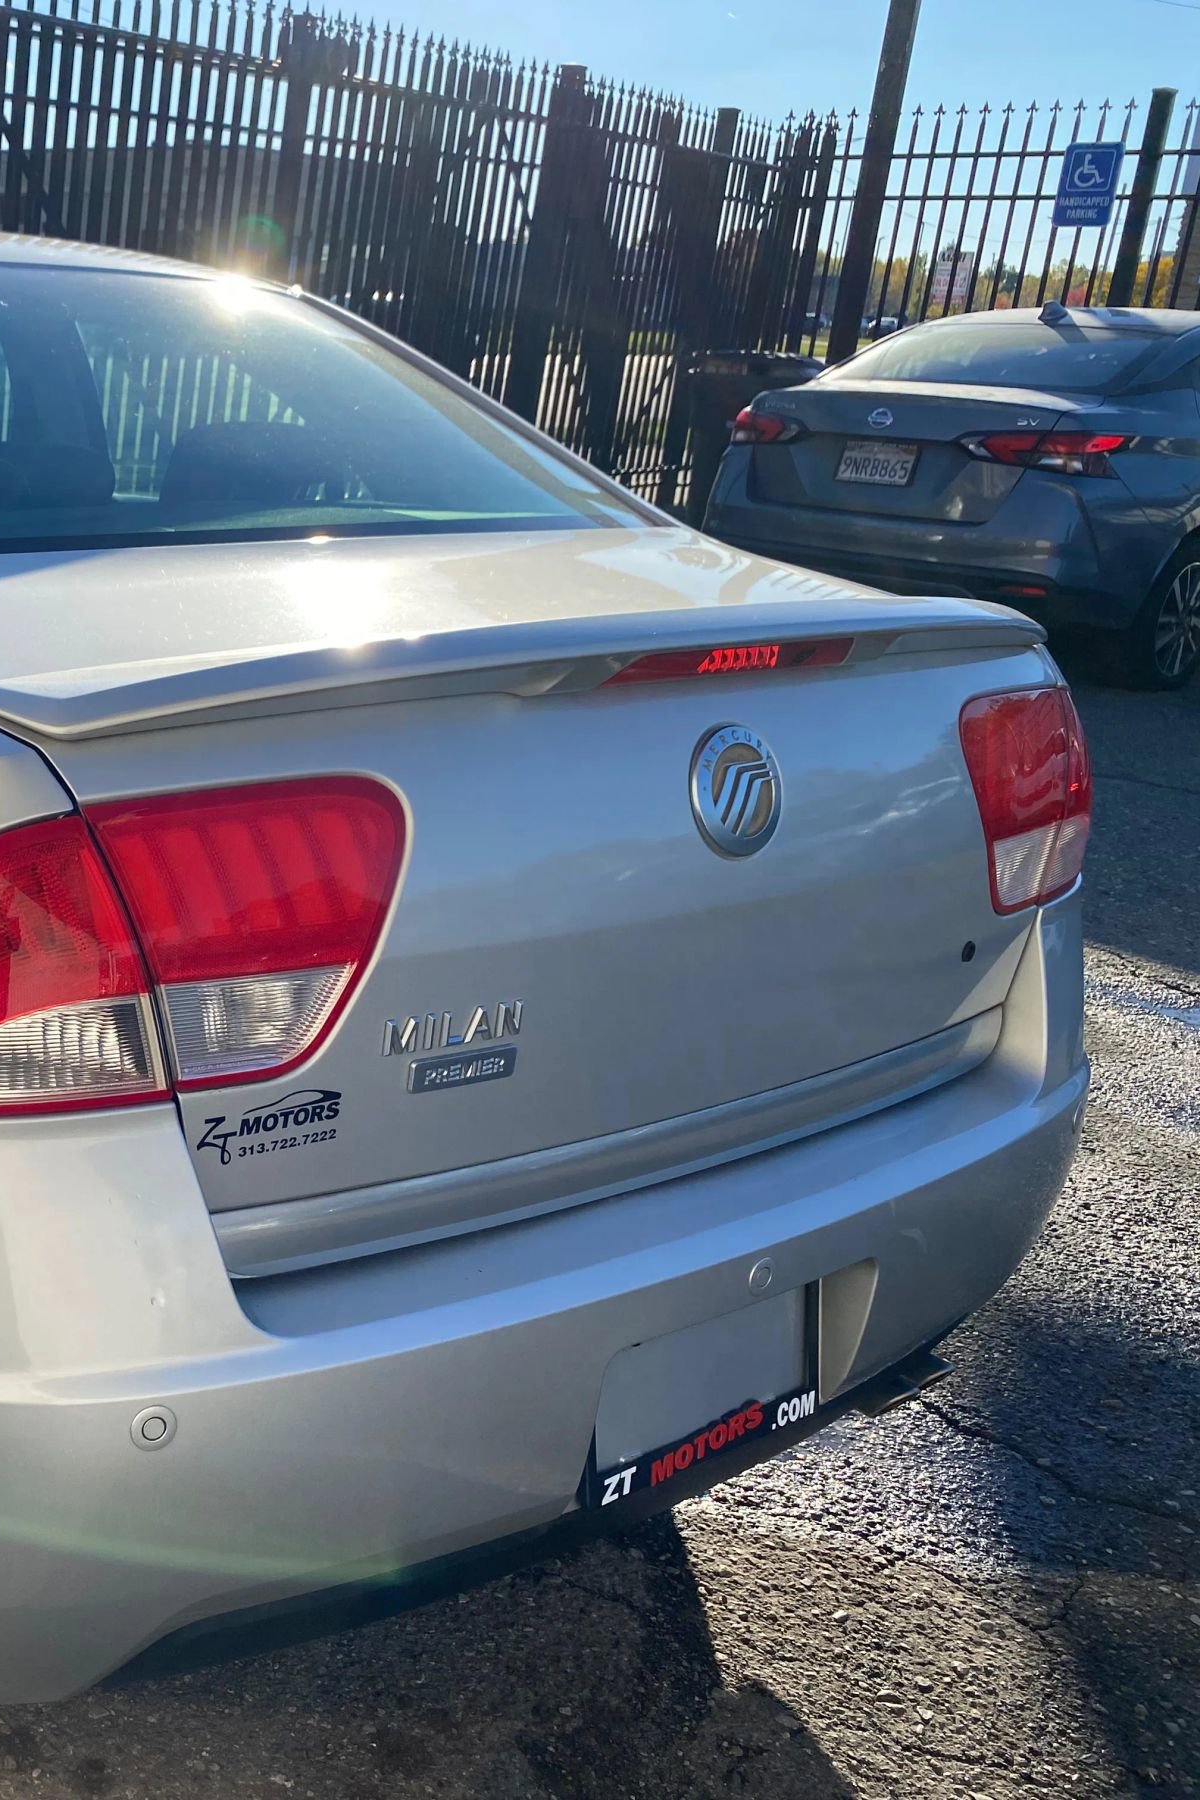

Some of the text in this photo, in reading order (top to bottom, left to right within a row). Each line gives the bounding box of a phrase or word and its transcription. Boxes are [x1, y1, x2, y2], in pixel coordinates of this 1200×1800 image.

[1059, 196, 1110, 207] HANDICAPPED
[1066, 208, 1098, 219] PARKING
[841, 456, 911, 481] 9NRB865
[381, 1000, 525, 1057] MILAN
[423, 1054, 506, 1086] PREMIER
[238, 1100, 342, 1138] MOTORS
[238, 1128, 338, 1158] 313.722.7222
[601, 1390, 816, 1507] ZT MOTORS .COM
